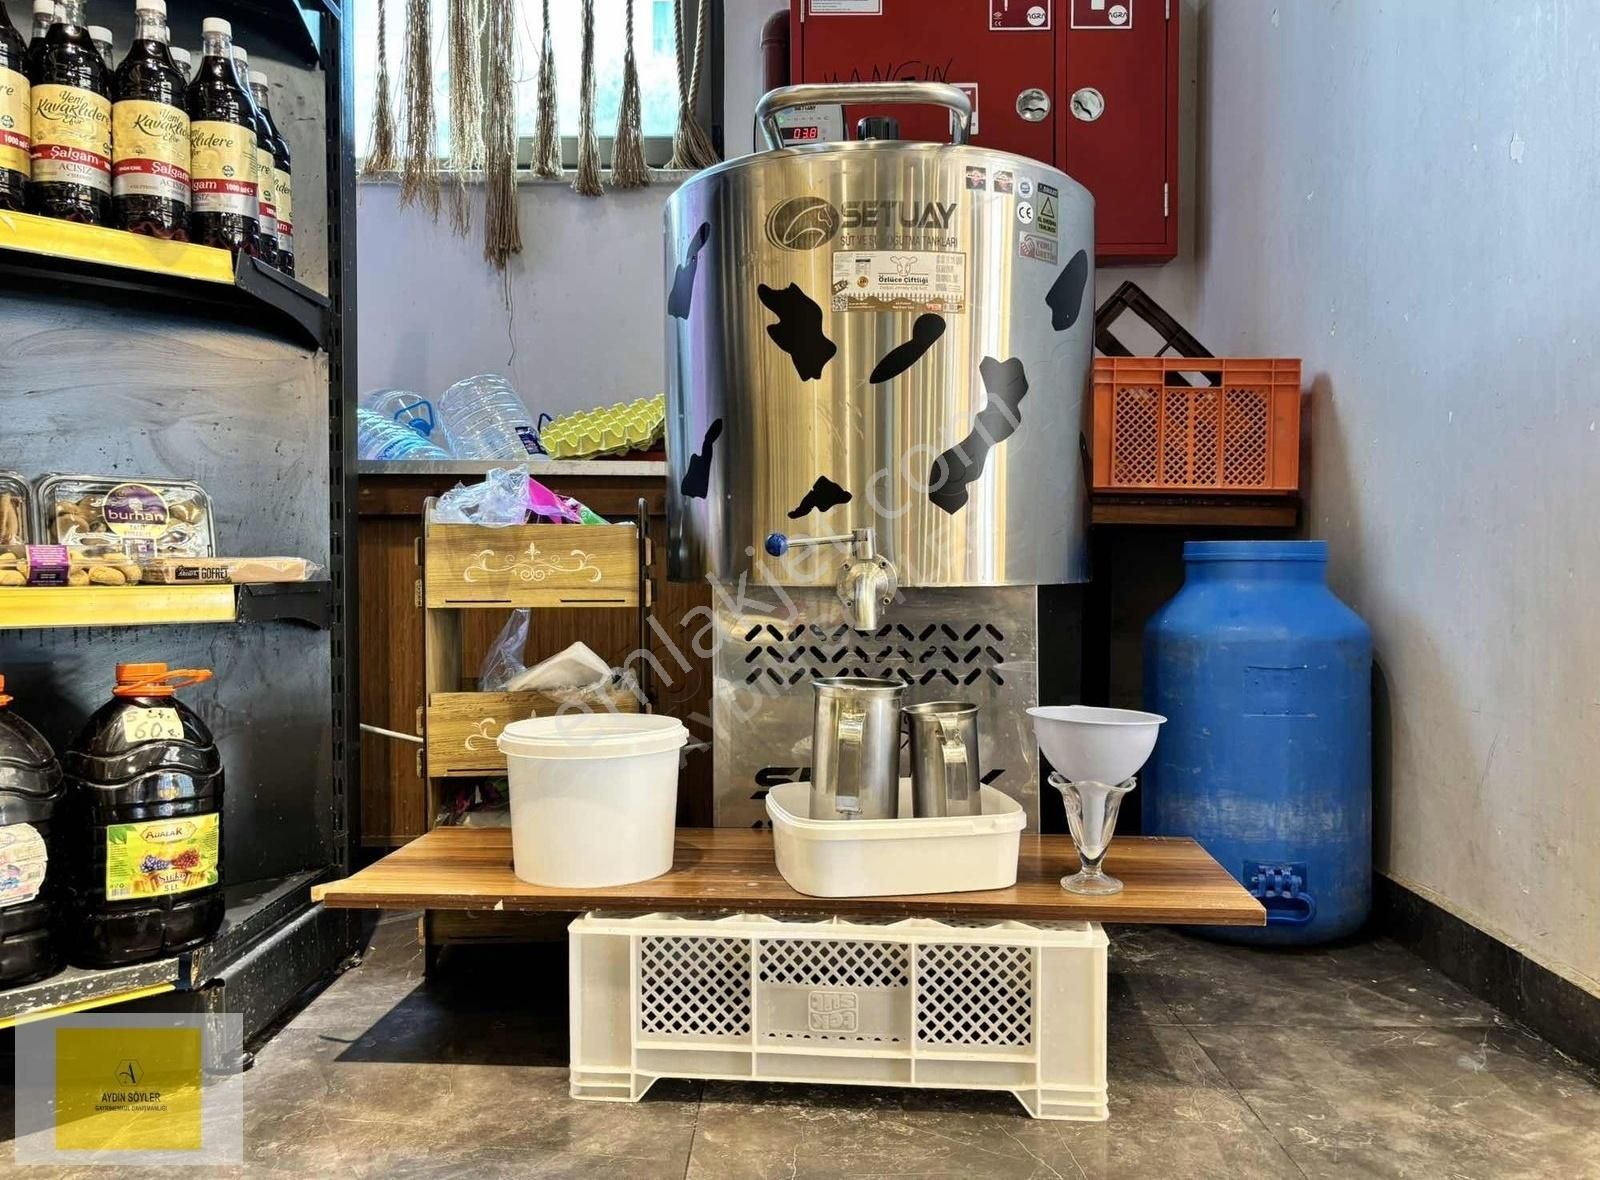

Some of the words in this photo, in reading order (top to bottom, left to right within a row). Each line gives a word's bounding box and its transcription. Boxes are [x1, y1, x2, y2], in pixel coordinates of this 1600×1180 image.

[50, 146, 98, 164] Şalgam
[841, 200, 957, 229] SETUAY
[108, 509, 164, 521] burhan
[201, 567, 228, 580] GOFRET
[134, 722, 162, 740] 60
